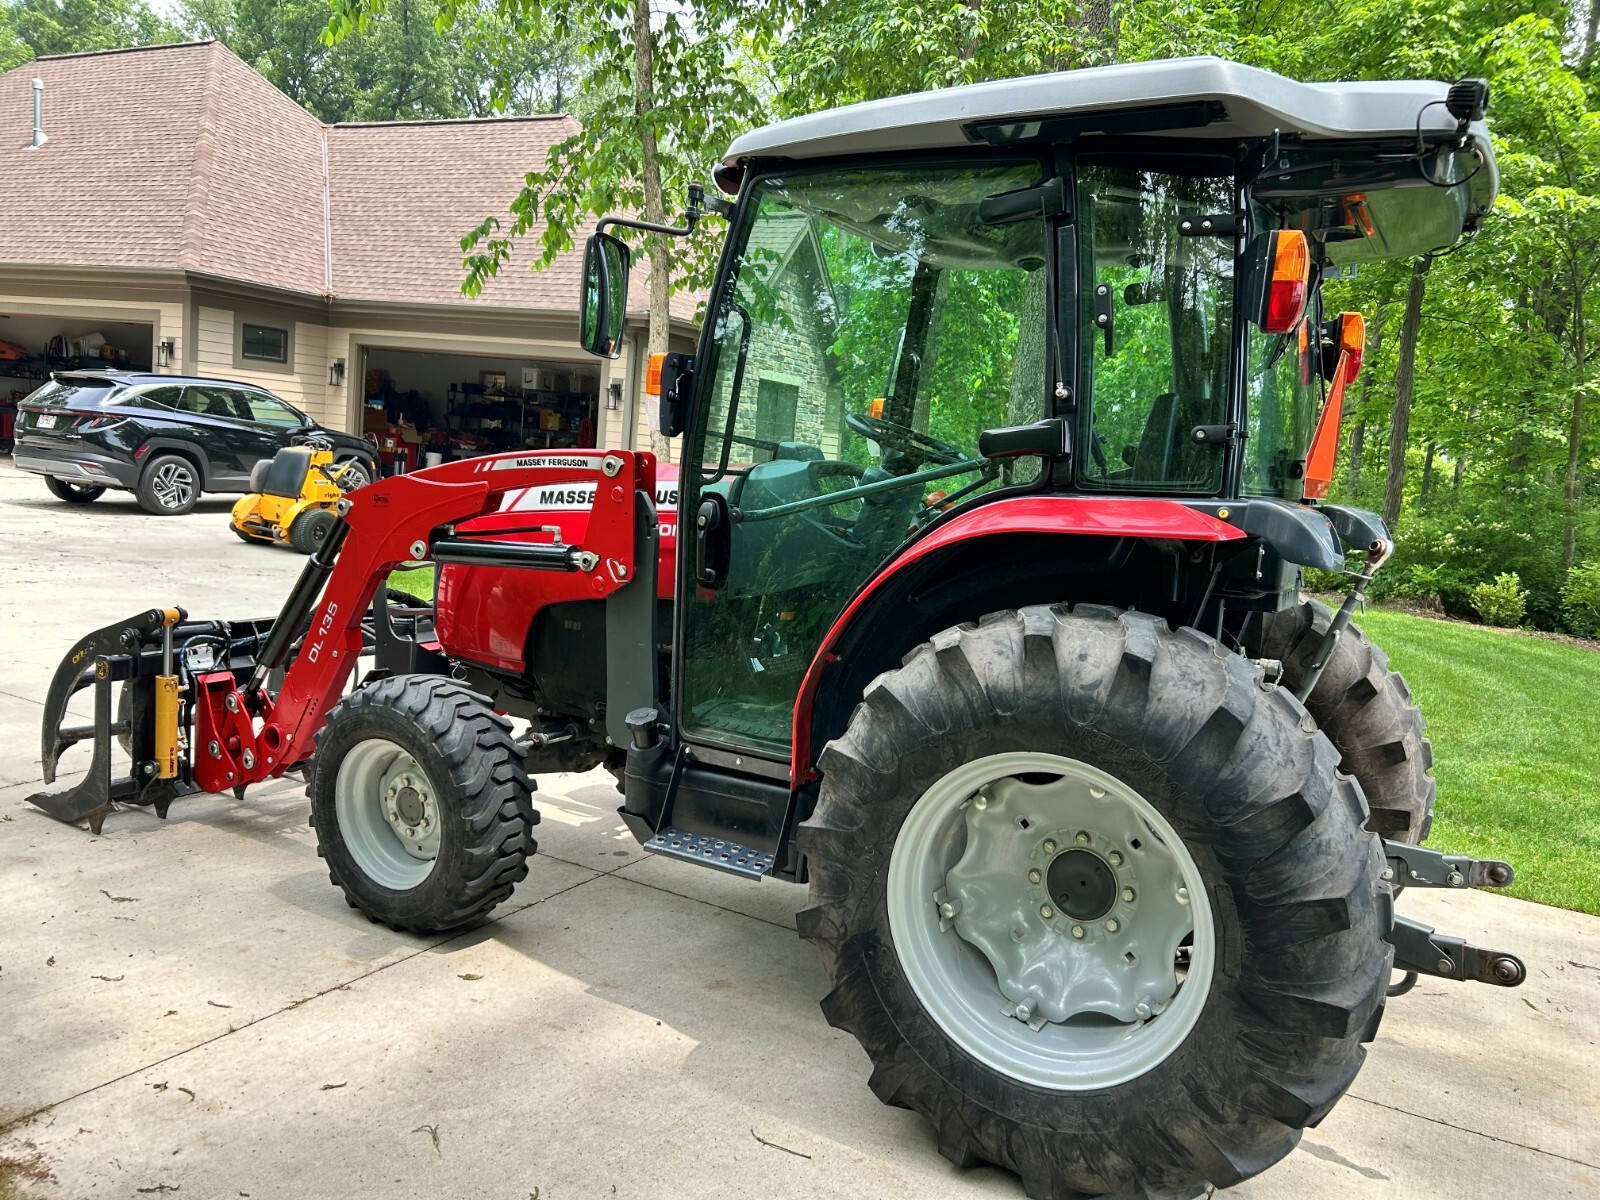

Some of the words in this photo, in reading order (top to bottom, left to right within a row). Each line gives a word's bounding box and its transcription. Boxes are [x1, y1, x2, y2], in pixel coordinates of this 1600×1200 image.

[516, 458, 546, 467] MASSEY
[548, 458, 588, 467] FERGUSON
[539, 490, 597, 505] MASSE
[308, 640, 324, 663] DL
[318, 600, 338, 636] 135
